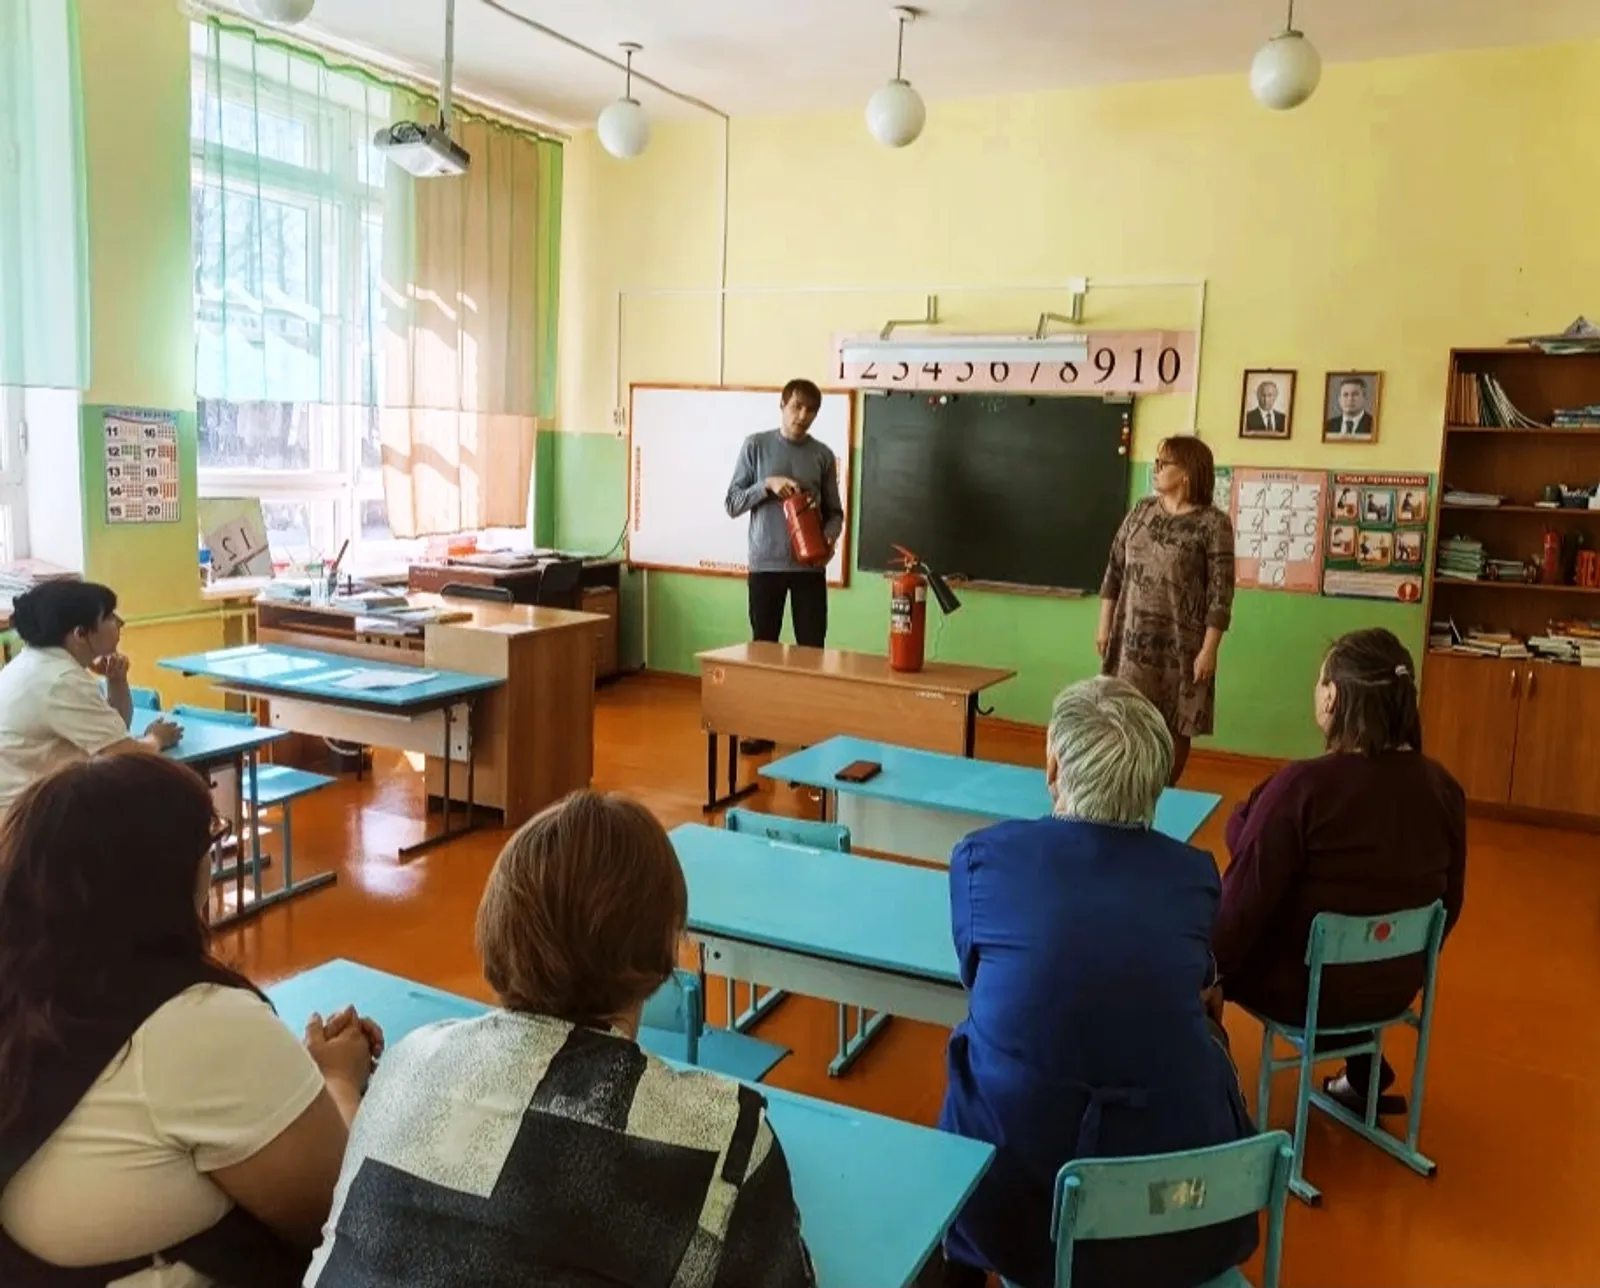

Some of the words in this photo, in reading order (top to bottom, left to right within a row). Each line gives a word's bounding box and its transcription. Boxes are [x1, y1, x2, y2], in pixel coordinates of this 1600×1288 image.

[1094, 348, 1116, 385] 9
[106, 427, 119, 437] 11
[144, 428, 156, 438] 16
[108, 447, 120, 456] 12
[145, 448, 156, 458] 17
[108, 467, 120, 477] 13
[145, 468, 157, 477] 18
[109, 486, 122, 496] 14
[146, 487, 159, 497] 19
[109, 506, 122, 515] 15
[147, 505, 160, 515] 20
